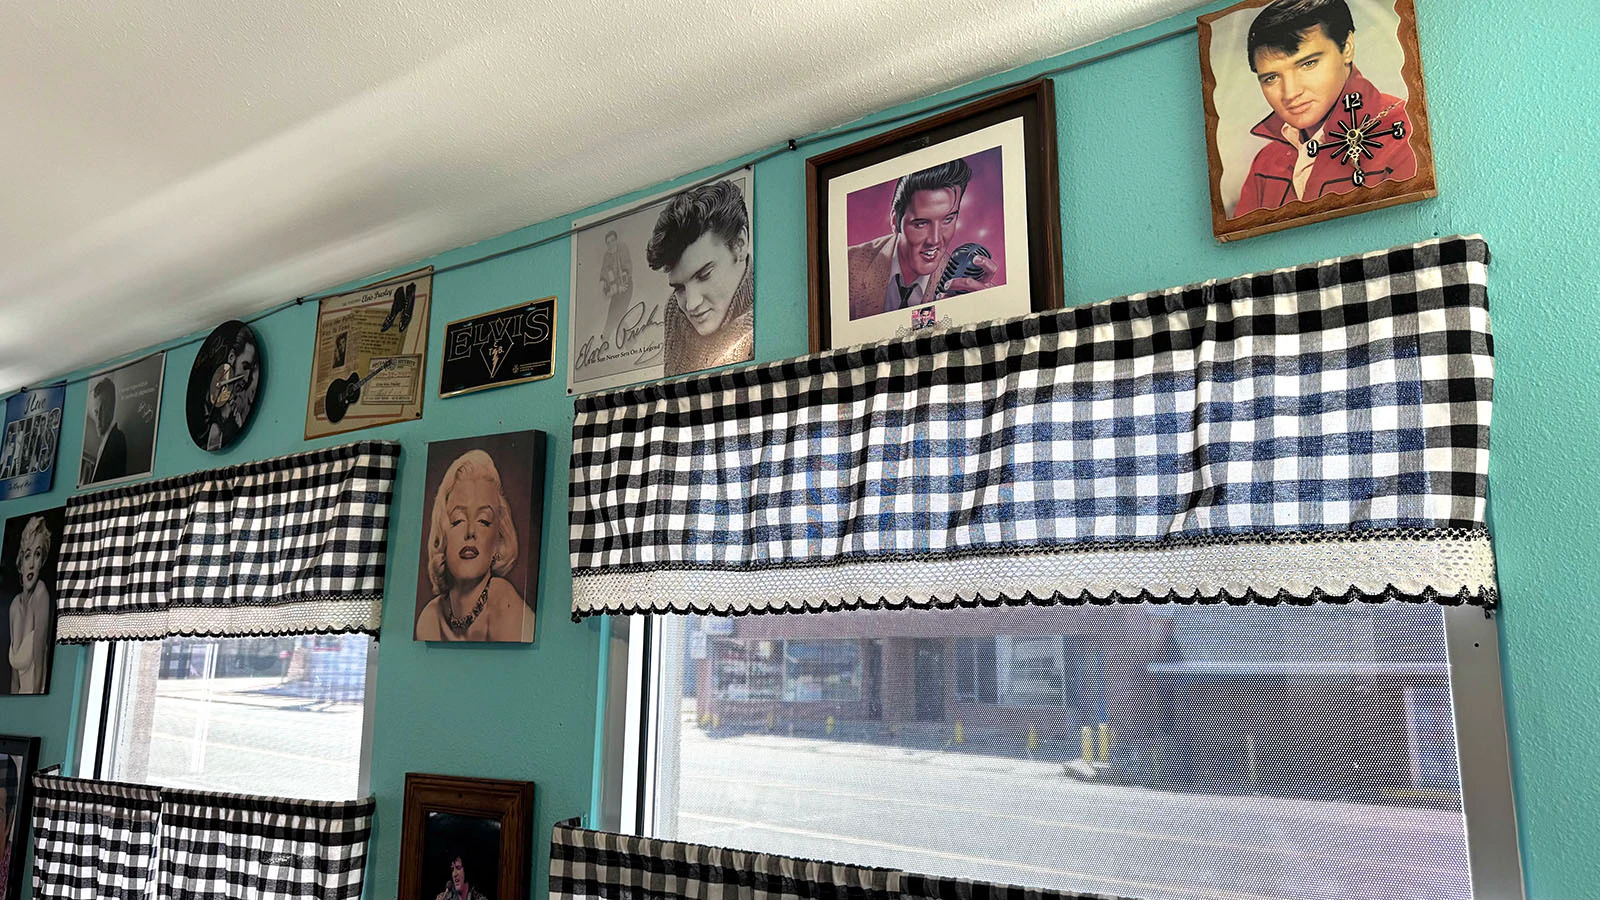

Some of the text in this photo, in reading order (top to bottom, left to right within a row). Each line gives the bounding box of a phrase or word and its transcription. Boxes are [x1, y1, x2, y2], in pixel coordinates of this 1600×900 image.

[1342, 91, 1363, 112] 12
[1392, 121, 1405, 140] 3
[1306, 140, 1319, 158] 9
[1352, 169, 1365, 188] 6
[447, 307, 550, 362] ELVIS
[575, 334, 609, 371] Elvis
[606, 353, 621, 361] Never
[620, 350, 630, 358] Sets
[643, 344, 661, 352] Legend
[0, 407, 61, 480] ELVIS
